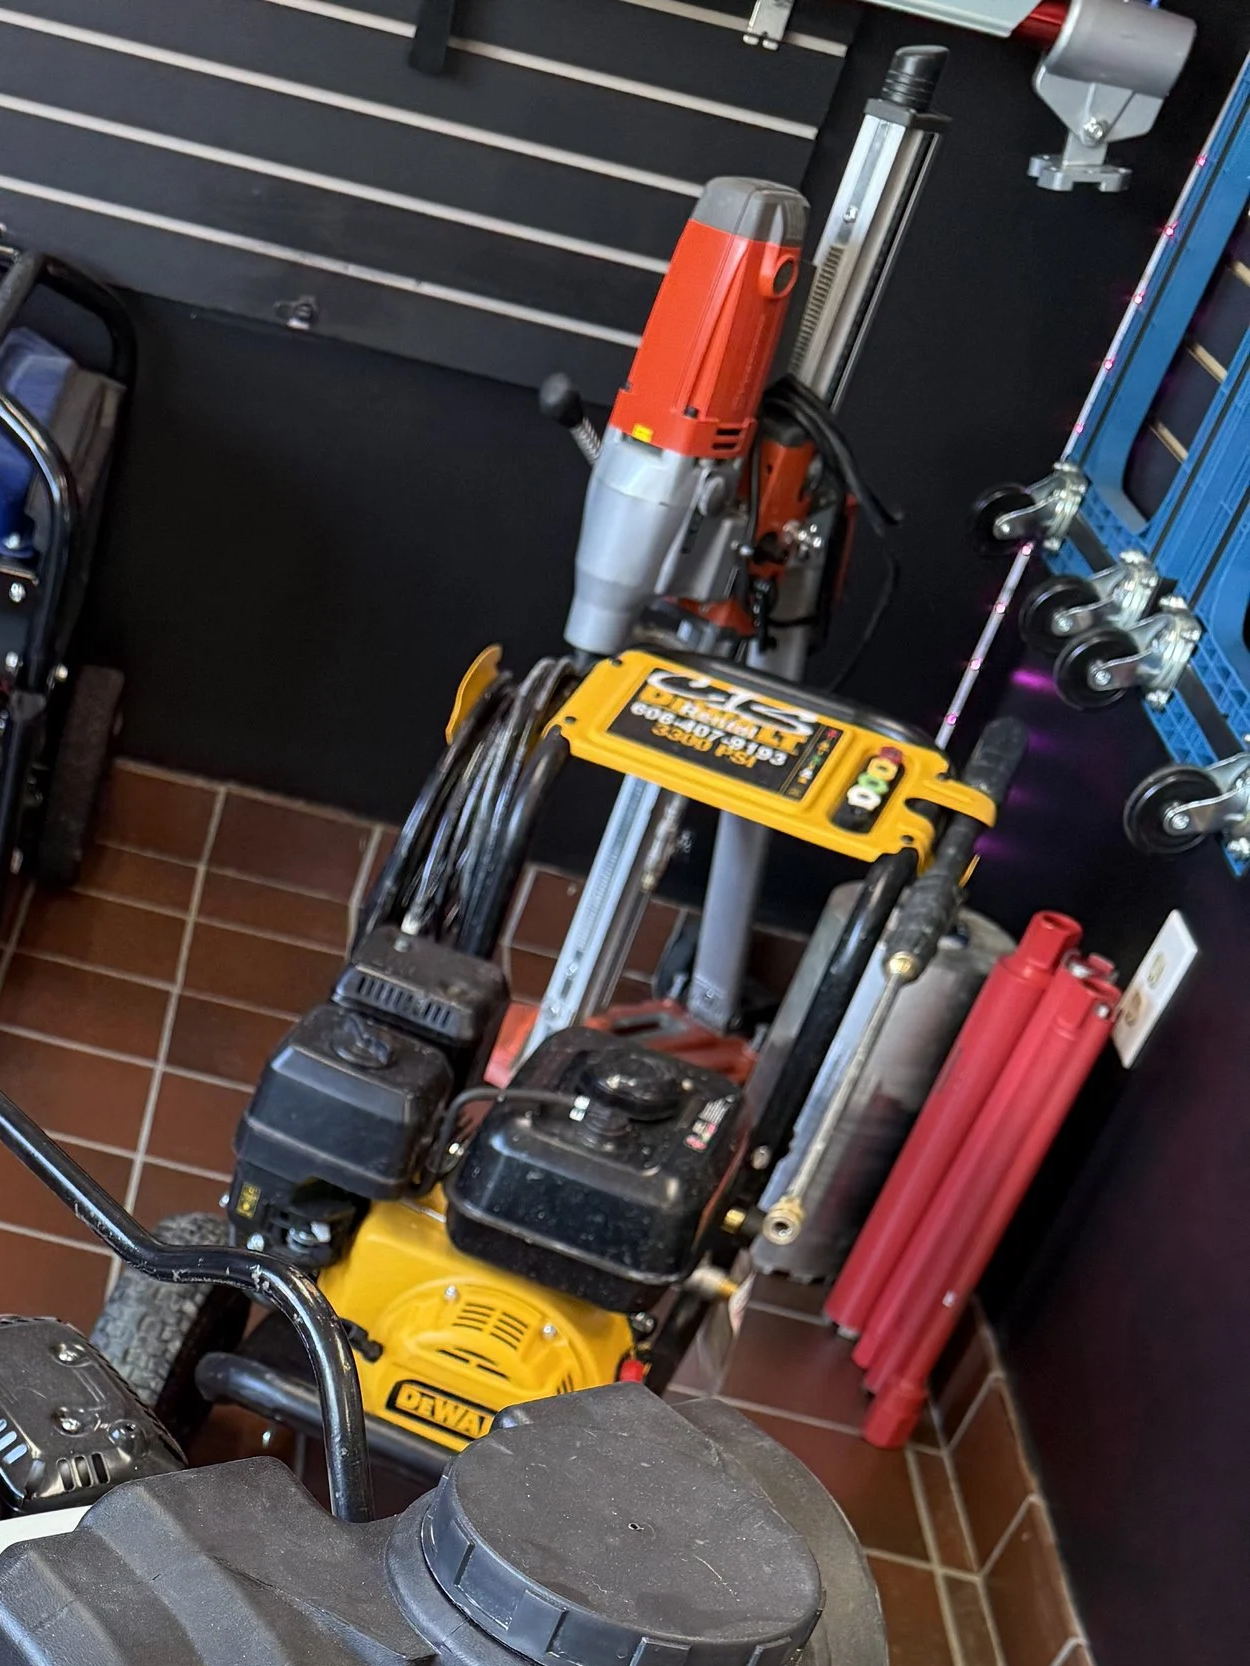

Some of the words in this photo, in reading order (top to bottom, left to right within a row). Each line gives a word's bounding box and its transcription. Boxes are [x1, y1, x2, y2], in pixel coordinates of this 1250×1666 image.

[629, 701, 787, 767] 606-407-9193
[651, 722, 713, 752] 3300
[714, 743, 757, 768] PSI
[395, 1385, 492, 1439] DEWA
